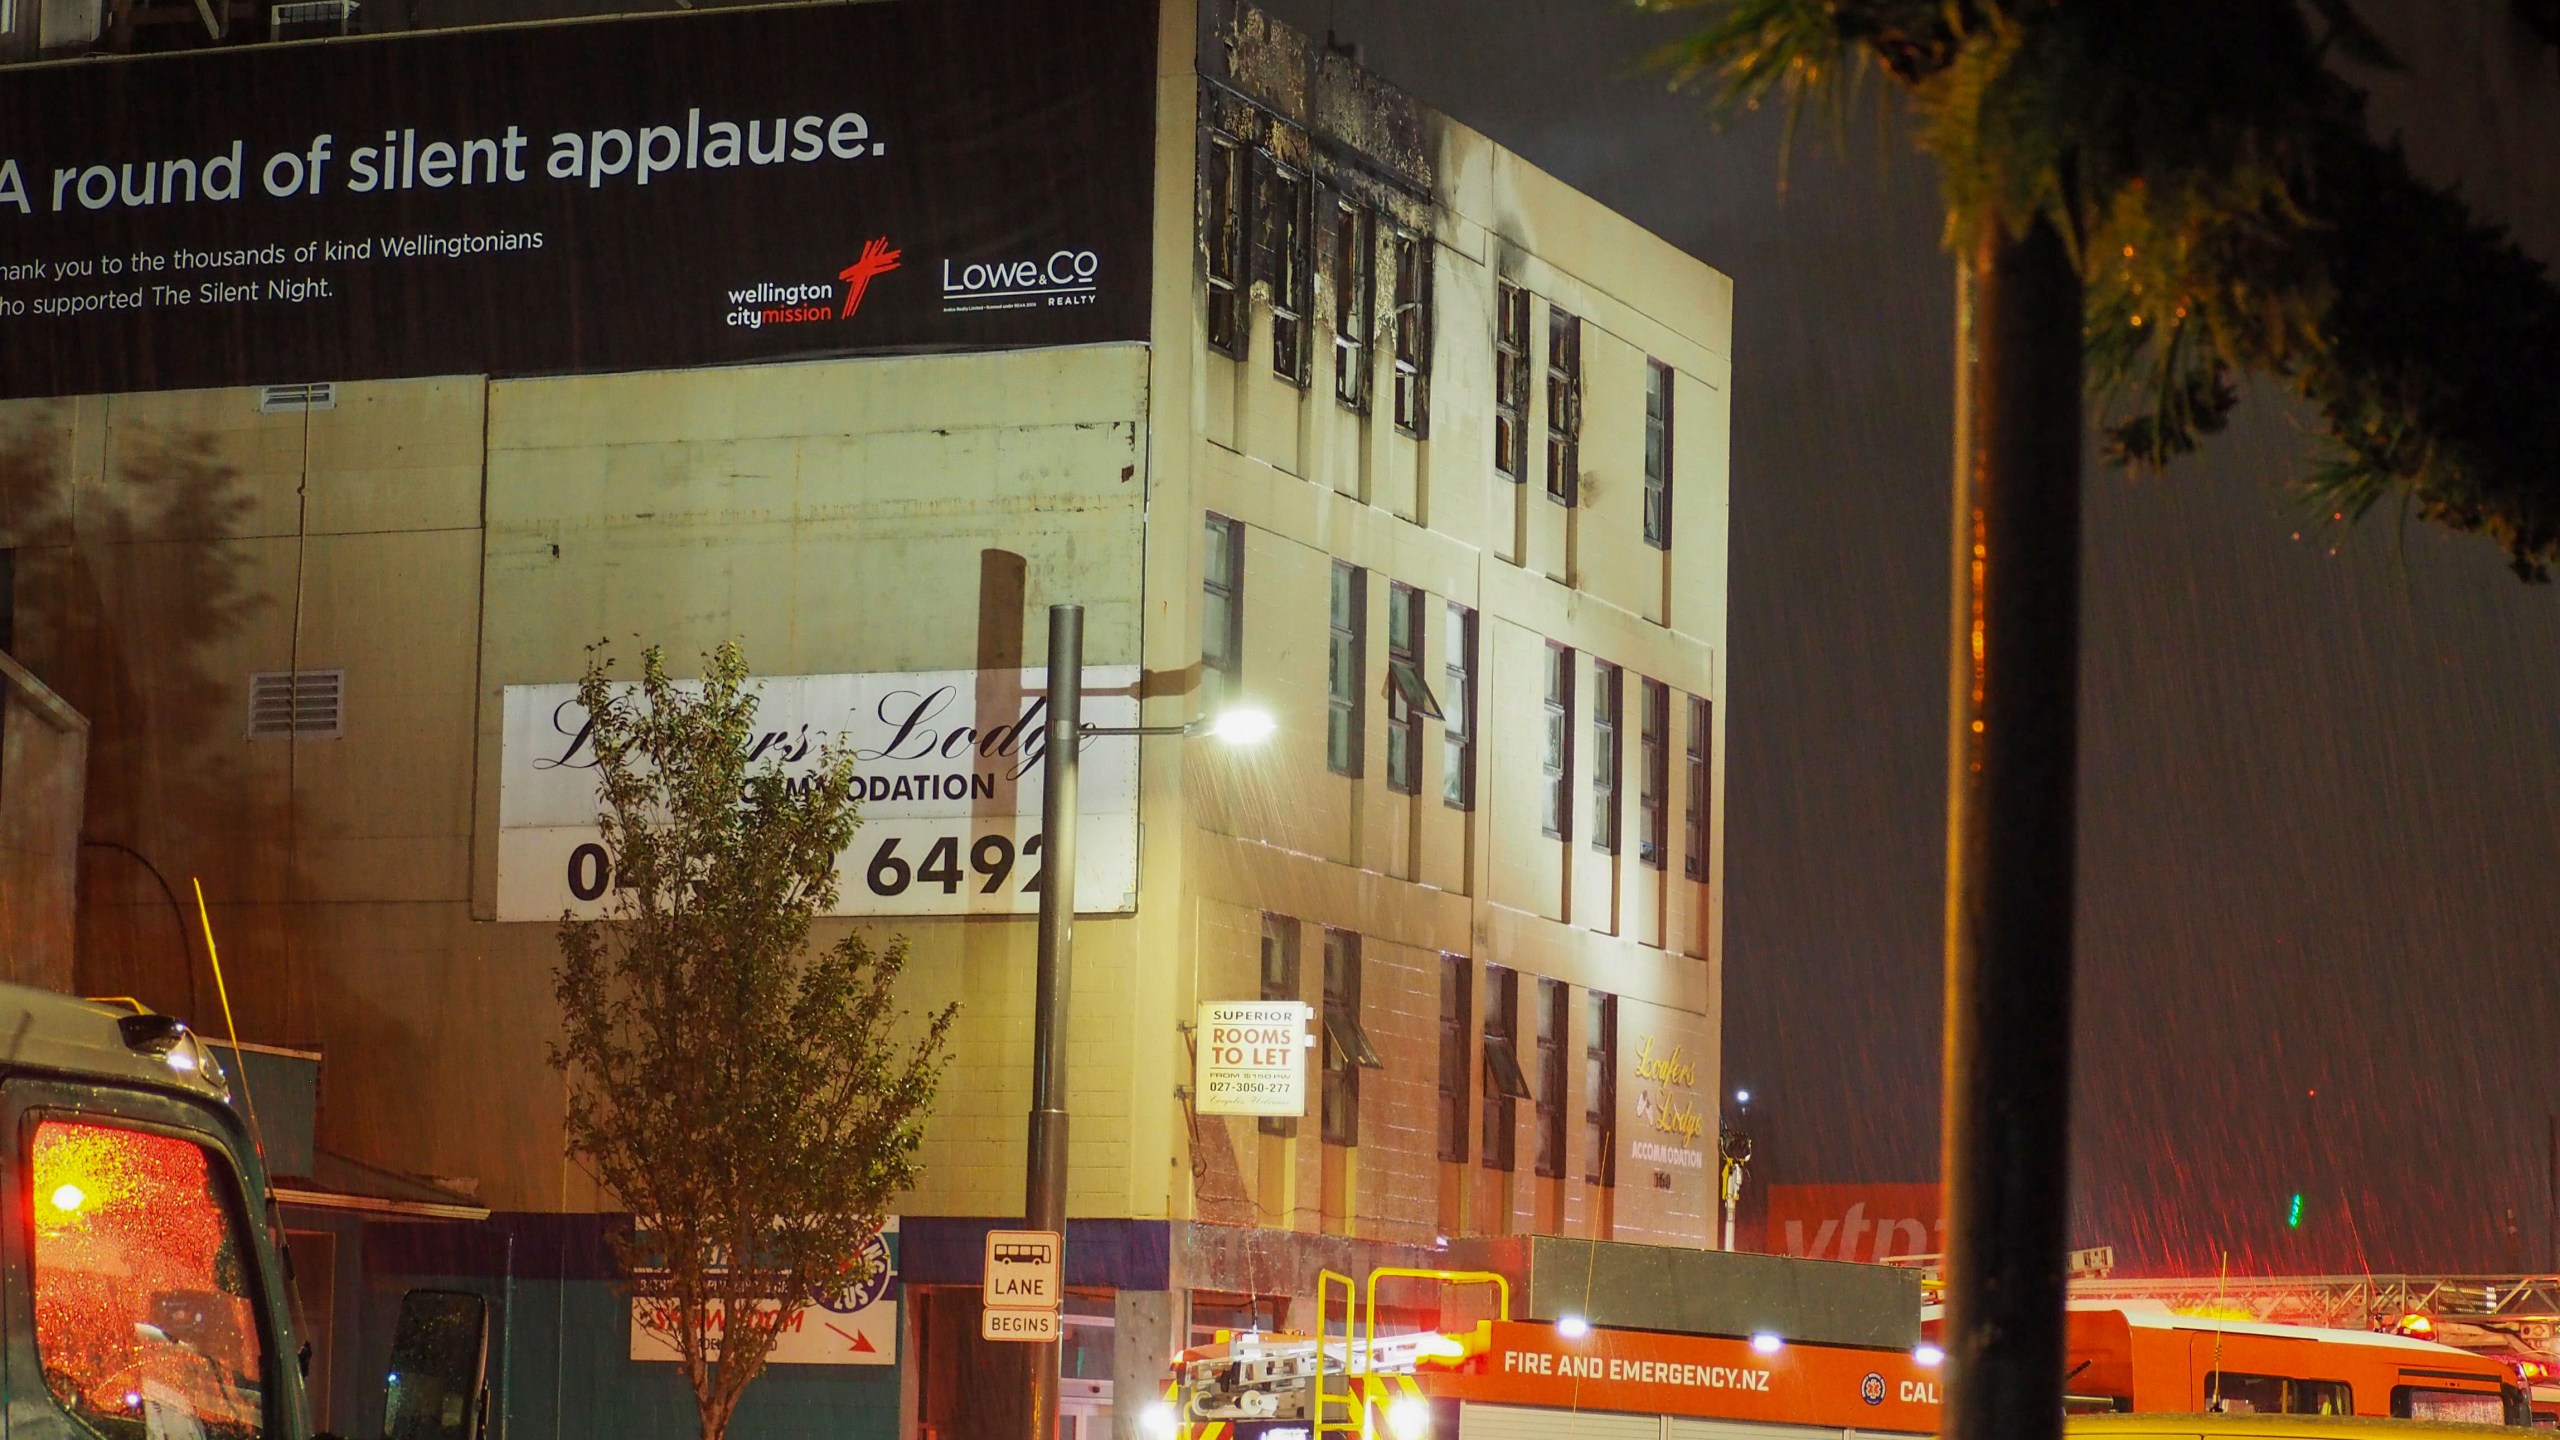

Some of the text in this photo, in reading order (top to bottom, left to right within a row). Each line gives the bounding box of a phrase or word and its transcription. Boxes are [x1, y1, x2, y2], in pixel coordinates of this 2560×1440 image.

[0, 107, 885, 214] A round of silent applause.
[54, 260, 93, 282] you
[102, 255, 123, 275] to
[131, 251, 165, 272] the
[174, 244, 285, 271] thousands
[295, 241, 318, 263] of
[325, 238, 371, 263] kind
[380, 229, 543, 259] Wellingtonians
[33, 287, 143, 317] supported
[153, 285, 191, 306] The
[200, 280, 259, 304] Silent
[268, 276, 333, 303] Night.
[728, 283, 832, 305] wellington
[1048, 295, 1096, 306] REALTY
[1213, 1010, 1292, 1021] SUPERIOR
[1213, 1028, 1291, 1045] ROOMS
[1212, 1047, 1290, 1065] TO LET
[1635, 1035, 1696, 1088] Loafers
[1210, 1082, 1290, 1093] 027-3050-277
[1655, 1088, 1703, 1148] Lodge
[1632, 1141, 1702, 1168] ACCOMMODATION
[1785, 1202, 1947, 1270] vtn
[995, 1278, 1044, 1296] LANE
[991, 1317, 1049, 1333] BEGINS
[1505, 1350, 1770, 1392] FIRE AND EMERGENCY.NZ
[1900, 1381, 1943, 1404] CAL
